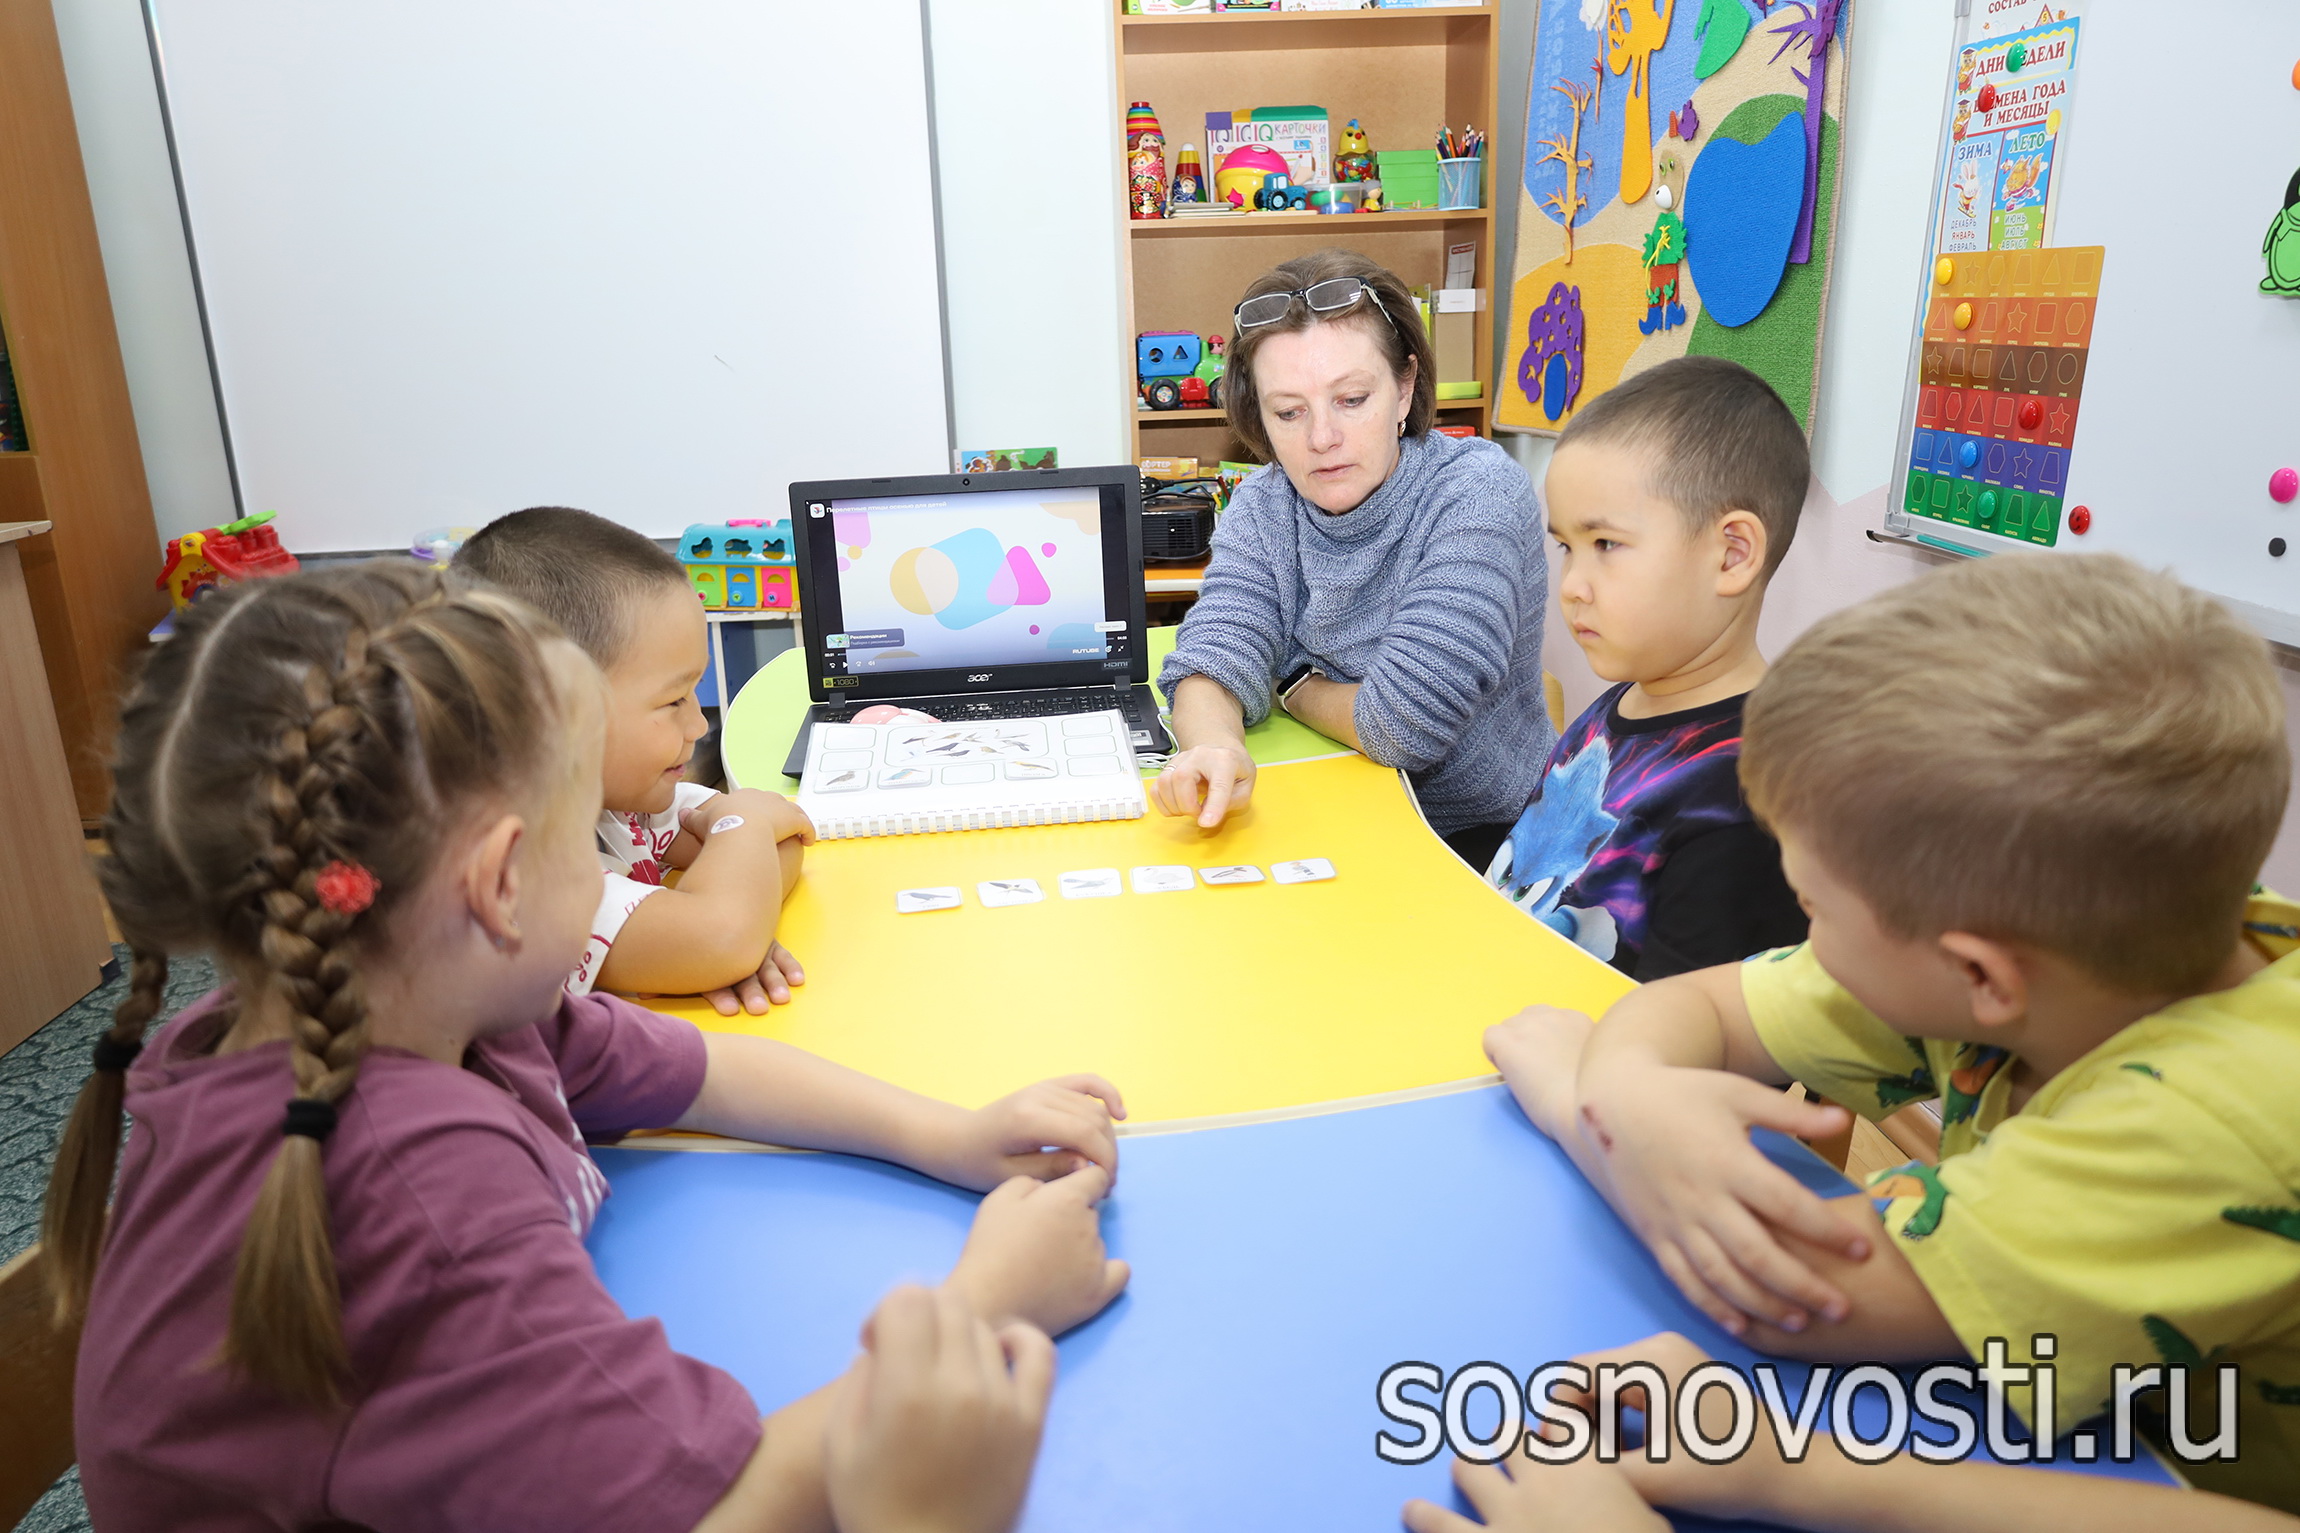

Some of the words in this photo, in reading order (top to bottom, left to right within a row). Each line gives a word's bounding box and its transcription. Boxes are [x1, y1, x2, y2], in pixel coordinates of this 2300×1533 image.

[1976, 55, 2005, 77] ДНИ
[2020, 41, 2066, 67] ЕДЕЛИ
[2032, 79, 2066, 100] ГОДА
[1983, 112, 1993, 128] И
[1996, 100, 2050, 125] МЕСЯЦЫ
[1254, 123, 1273, 142] IQ
[1274, 122, 1326, 135] КАРТОЧКИ
[2010, 133, 2046, 153] ЛЕТО
[1958, 142, 1992, 160] ЗИМА
[1950, 219, 1977, 230] ДЕКАБРЬ
[2005, 214, 2027, 224] ИЮНЬ
[1951, 230, 1976, 240] ЯНВАРЬ
[2005, 227, 2025, 237] ИЮЛЬ
[1949, 242, 1977, 252] ФЕВРАЛЬ
[967, 673, 993, 683] acer
